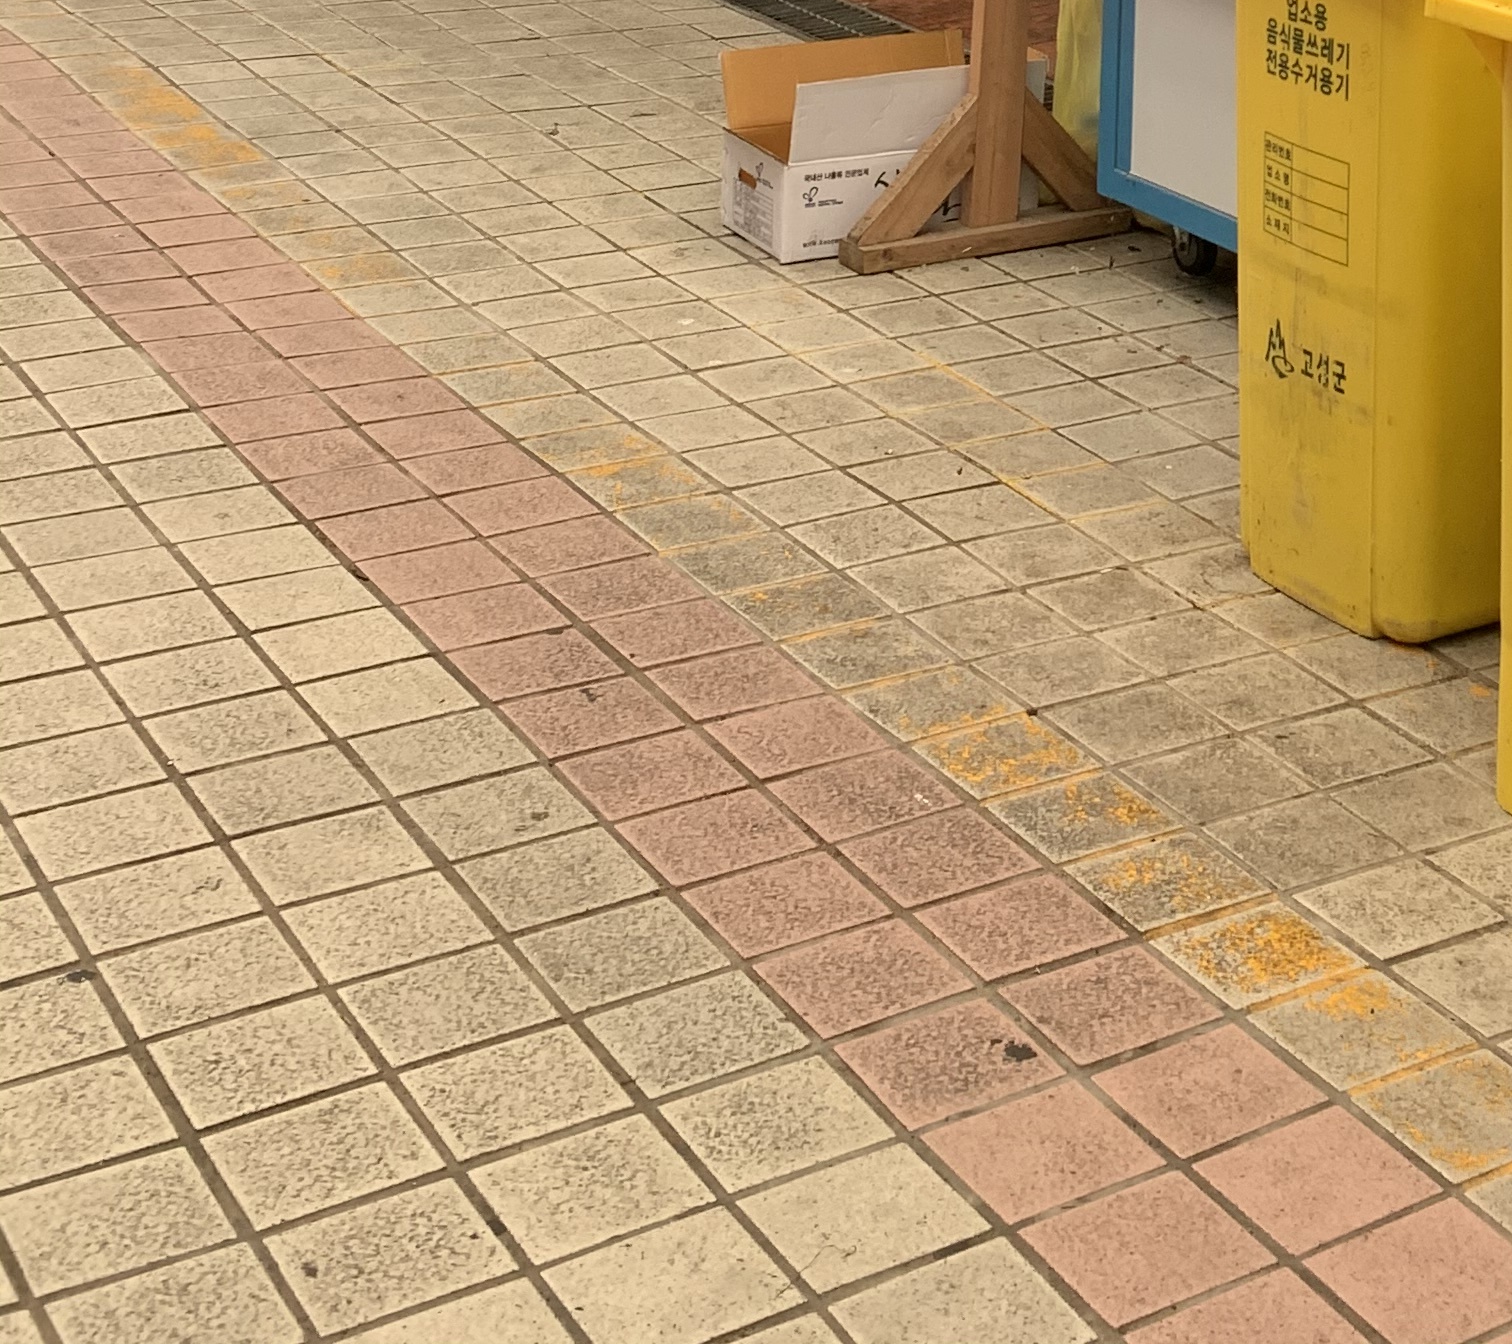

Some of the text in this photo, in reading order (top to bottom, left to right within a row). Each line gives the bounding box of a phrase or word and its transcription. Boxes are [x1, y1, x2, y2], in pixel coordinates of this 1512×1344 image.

[1266, 17, 1350, 71] 음식물쓰레기
[1265, 48, 1350, 102] 전용수거용기
[1299, 347, 1348, 396] 고성군
